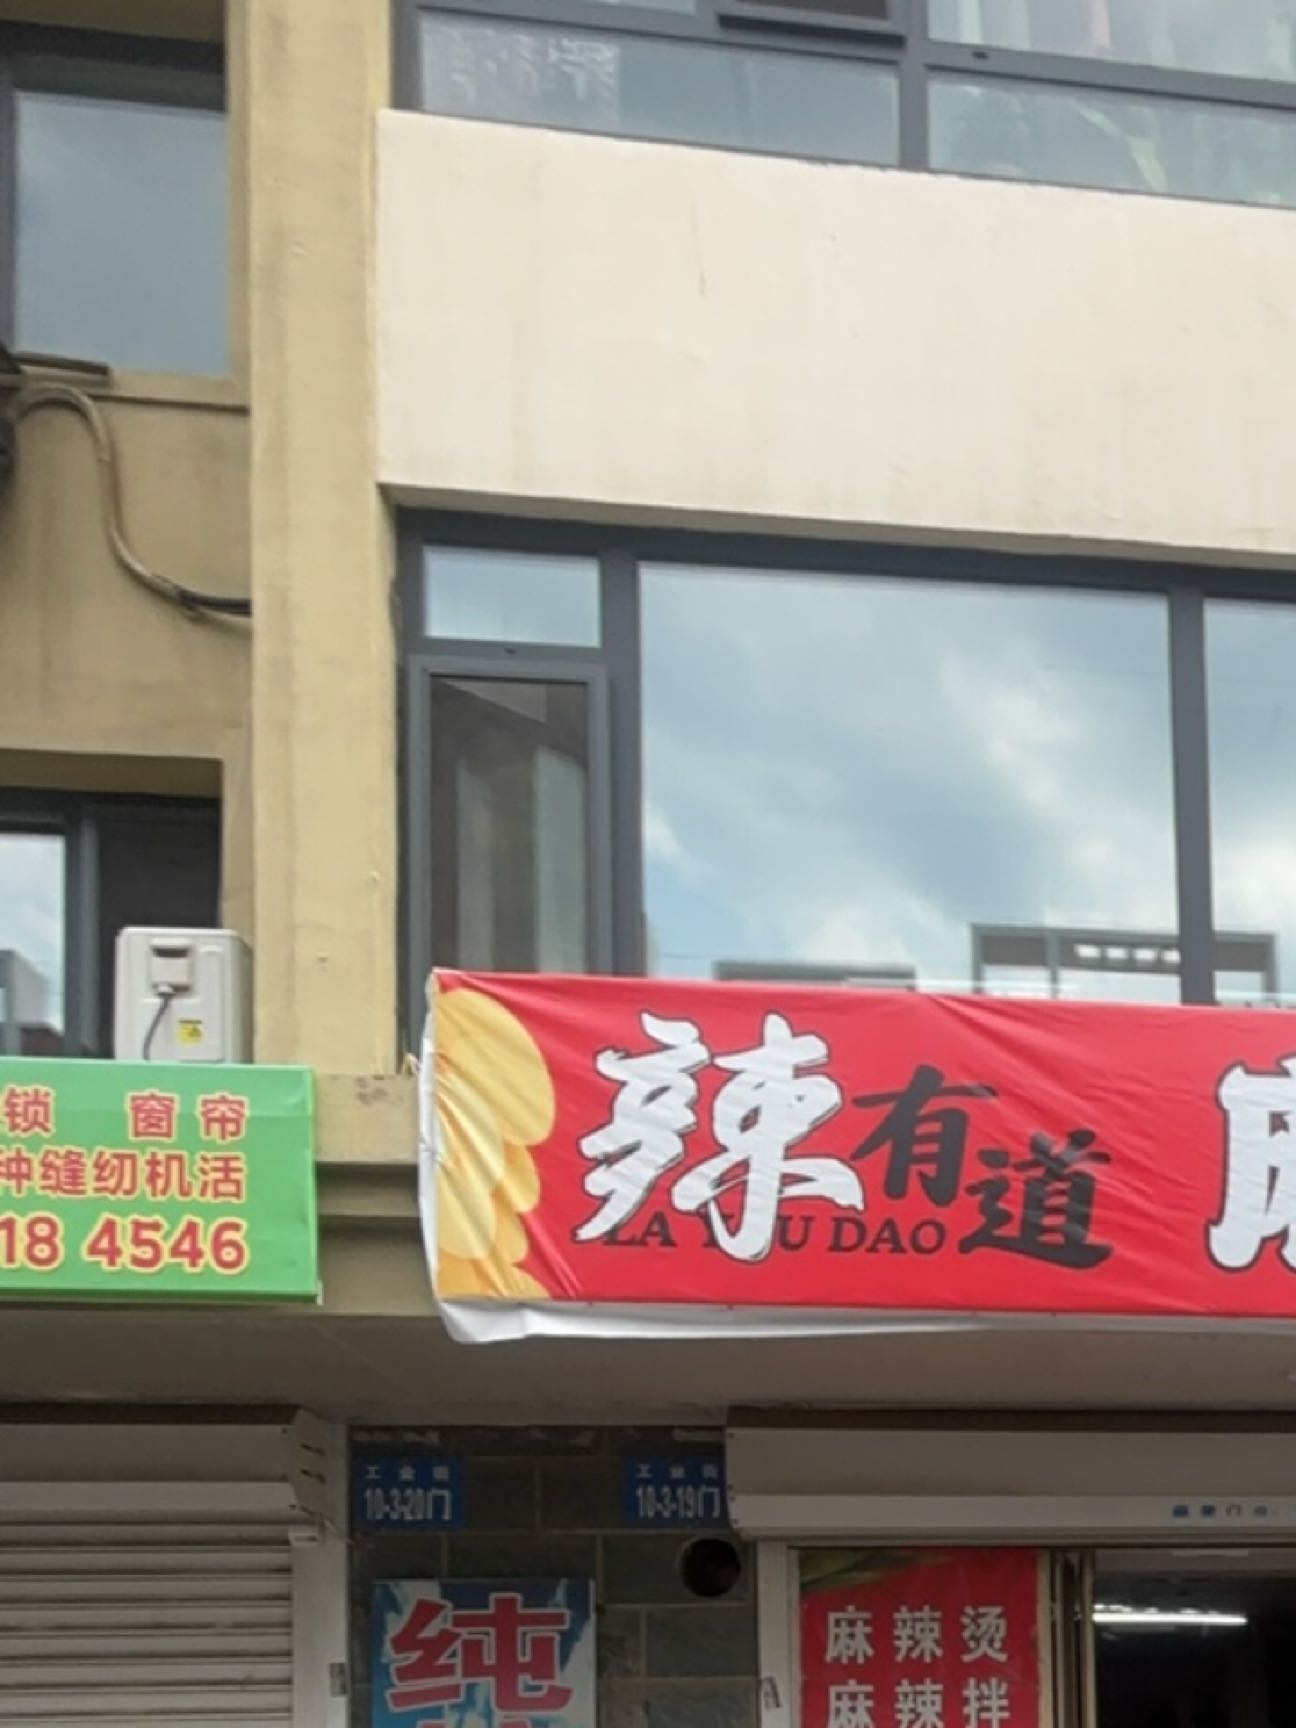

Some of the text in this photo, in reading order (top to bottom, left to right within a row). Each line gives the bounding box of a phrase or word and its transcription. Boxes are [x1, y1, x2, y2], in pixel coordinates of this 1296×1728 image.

[127, 1089, 248, 1142] 窗帘
[576, 1012, 1113, 1270] 辣有道
[84, 1214, 249, 1273] 4546
[827, 1215, 946, 1254] DAO
[825, 1605, 1009, 1664] 麻辣烫
